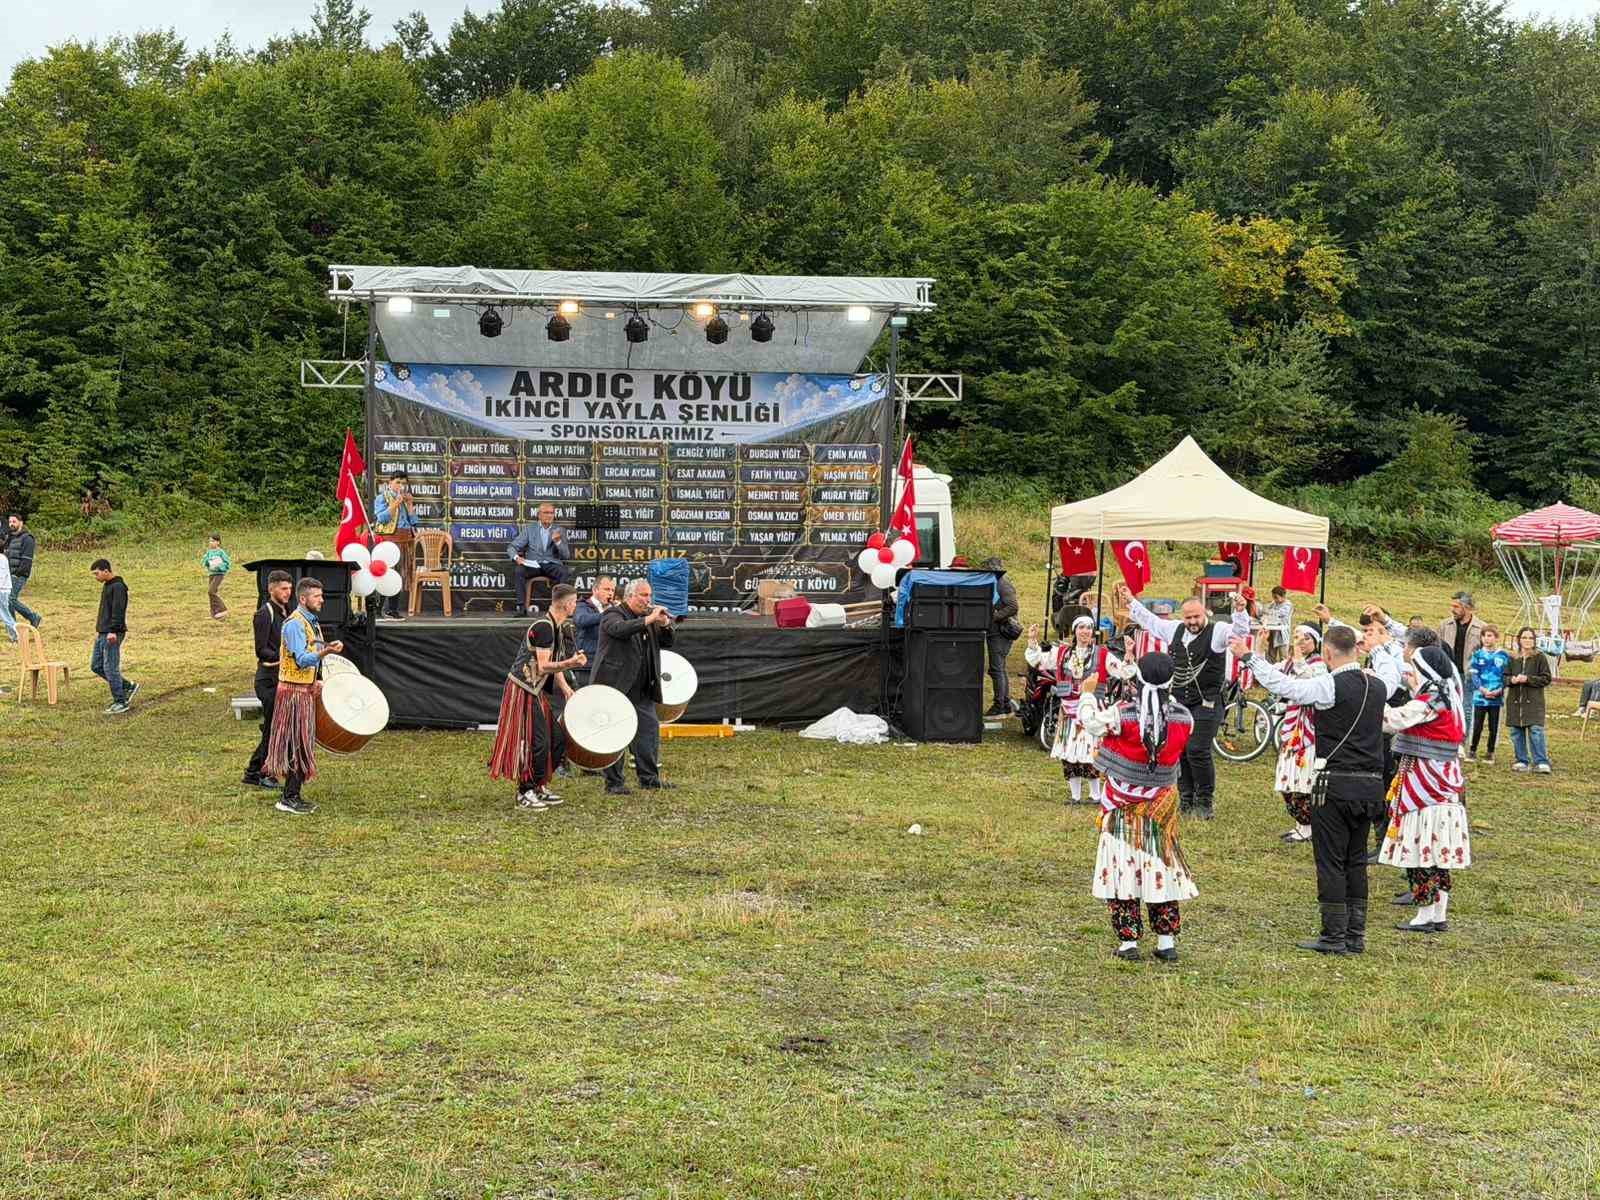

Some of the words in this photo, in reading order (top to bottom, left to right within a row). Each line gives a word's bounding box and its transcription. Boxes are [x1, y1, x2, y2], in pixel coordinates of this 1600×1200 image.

[510, 370, 634, 402] ARDIÇ
[654, 372, 750, 401] KÖYÜ
[485, 396, 570, 418] İKİNCİ
[584, 401, 666, 420] YAYLA
[678, 402, 780, 424] ŞENLİĞİ
[551, 424, 714, 440] SPONSORLARIMIZ
[383, 442, 409, 452] AHMET
[412, 442, 436, 452] SEVEN
[461, 444, 487, 453] AHMET
[490, 443, 509, 454] TÖRE
[532, 445, 543, 455] AR
[545, 445, 561, 455] YAPI
[564, 444, 585, 455] FATİH
[648, 448, 658, 456] AK
[677, 448, 703, 457] CENGİZ
[706, 447, 725, 458] YİĞİT
[749, 450, 779, 459] DURSUN
[782, 448, 800, 459] YİĞİT
[828, 449, 846, 460] EMİN
[849, 451, 867, 460] KAYA
[464, 463, 486, 474] ENGİN
[489, 465, 504, 475] MOL
[535, 465, 559, 475] ENGİN
[561, 464, 580, 476] YİĞİT
[605, 467, 629, 477] ERCAN
[632, 468, 656, 477] AYCAN
[697, 469, 726, 479] AKKAYA
[751, 469, 772, 479] FATİH
[456, 484, 487, 495] İBRAHİM
[489, 486, 512, 497] ÇAKIR
[534, 485, 560, 497] İSMAİL
[563, 485, 583, 497] YİĞİT
[606, 487, 632, 497] İSMAİL
[635, 487, 654, 498] YİĞİT
[677, 488, 703, 498] İSMAİL
[704, 488, 725, 499] YİĞİT
[748, 491, 778, 500] MEHMET
[780, 490, 799, 501] TÖRE
[821, 491, 847, 500] MURAT
[849, 490, 868, 500] YİĞİT
[414, 504, 431, 515] İĞİT
[454, 506, 486, 516] MUSTAFA
[489, 505, 513, 517] KESKİN
[635, 508, 654, 519] YİĞİT
[671, 508, 703, 520] OĞUZHAN
[705, 509, 730, 520] KESKİN
[748, 511, 773, 520] OSMAN
[775, 511, 798, 520] YAZICI
[824, 510, 845, 520] ÖMER
[847, 510, 865, 521] YİĞİT
[461, 528, 485, 537] RESUL
[488, 528, 507, 538] YİĞİT
[605, 532, 630, 540] YAKUP
[633, 531, 653, 540] KURT
[676, 532, 701, 541] YAKUP
[704, 531, 725, 542] YİĞİT
[750, 532, 773, 543] YAŞAR
[777, 532, 795, 542] YİĞİT
[820, 533, 847, 542] YILMAZ
[850, 531, 868, 542] YİĞİT
[575, 546, 688, 560] KÖYLERİMİZ
[472, 574, 506, 587] KÖYÜ
[808, 577, 836, 590] KÖYÜ
